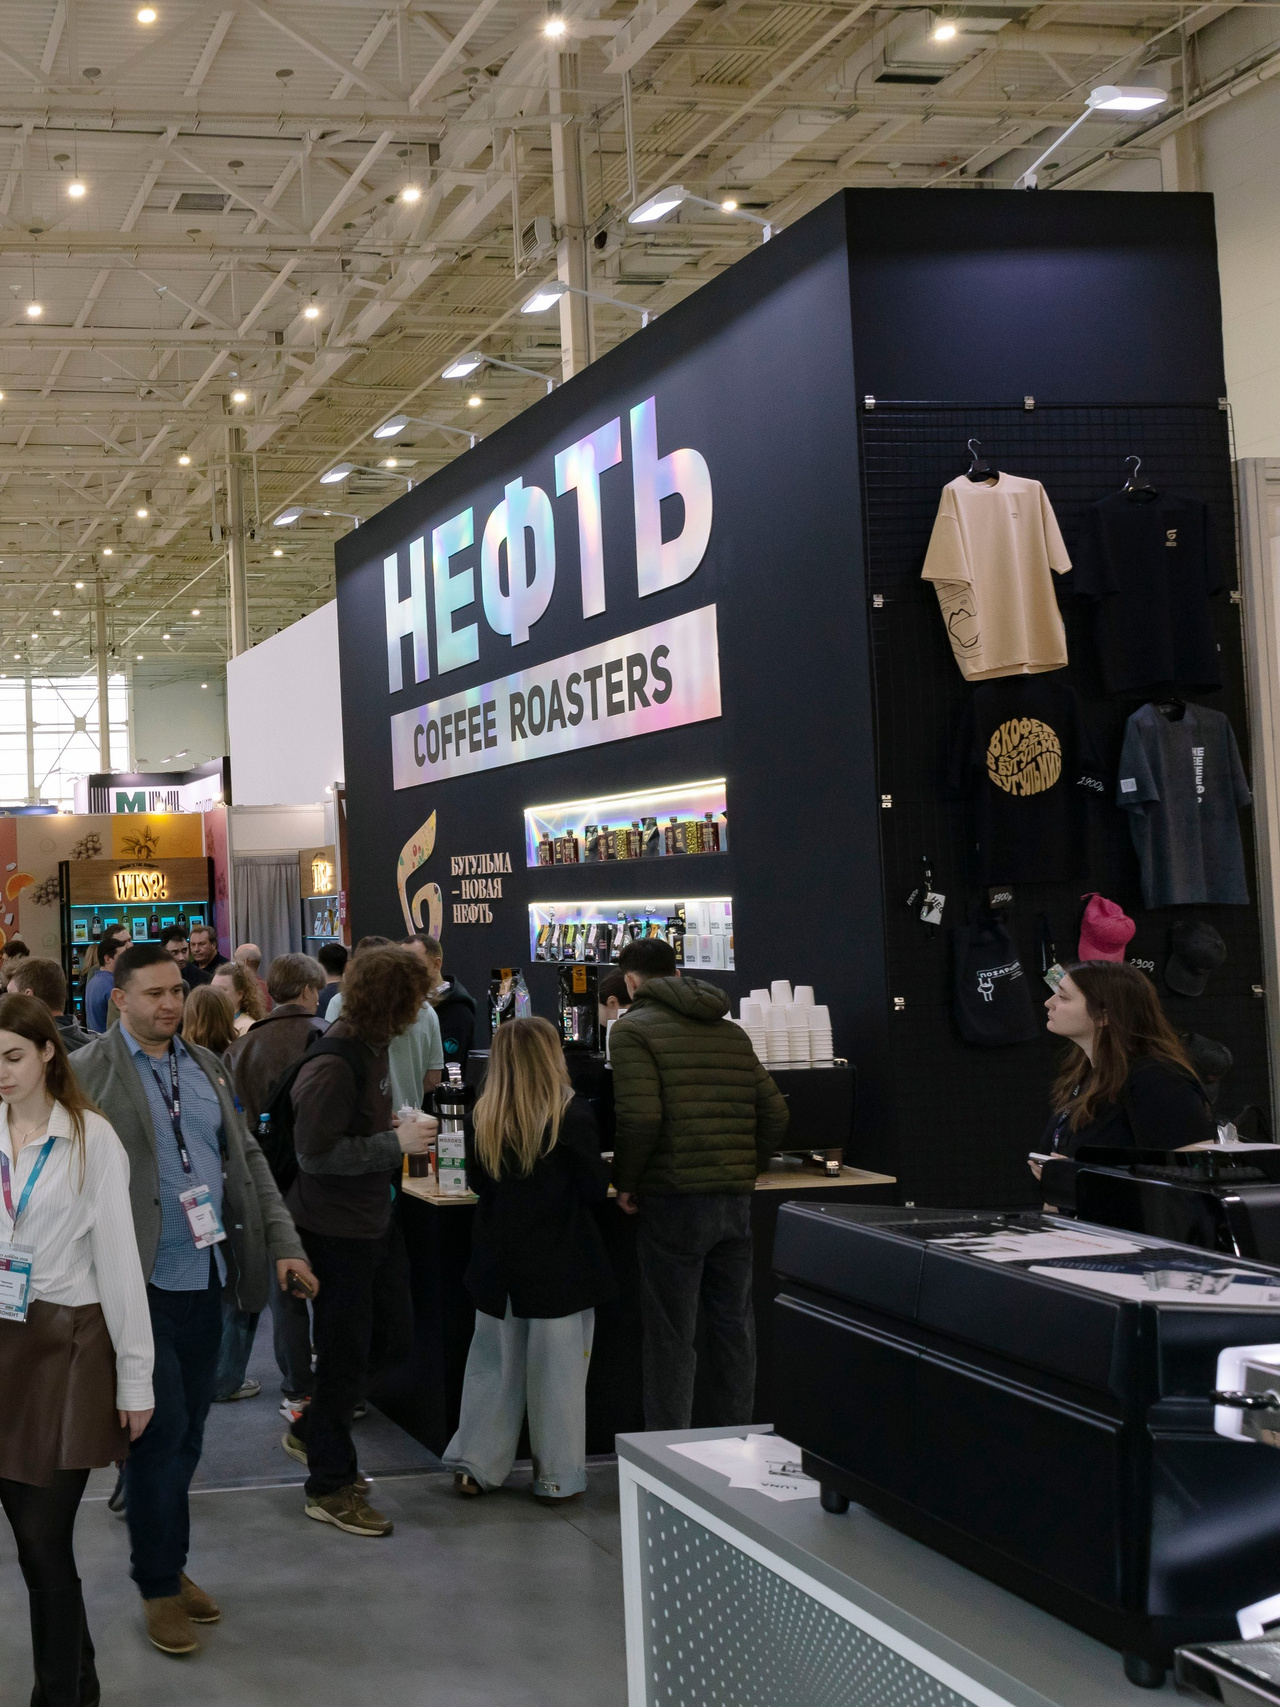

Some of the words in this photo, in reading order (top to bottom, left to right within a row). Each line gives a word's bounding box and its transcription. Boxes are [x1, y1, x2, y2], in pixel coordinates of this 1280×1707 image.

[383, 395, 714, 694] НЕФТЬ
[413, 699, 498, 768] COFFEE
[509, 644, 674, 743] ROASTERS
[450, 852, 513, 876] БУГУЛЬМА
[114, 873, 167, 899] WTS?!
[461, 878, 503, 899] НОВАЯ
[452, 903, 494, 924] НЕФТЬ
